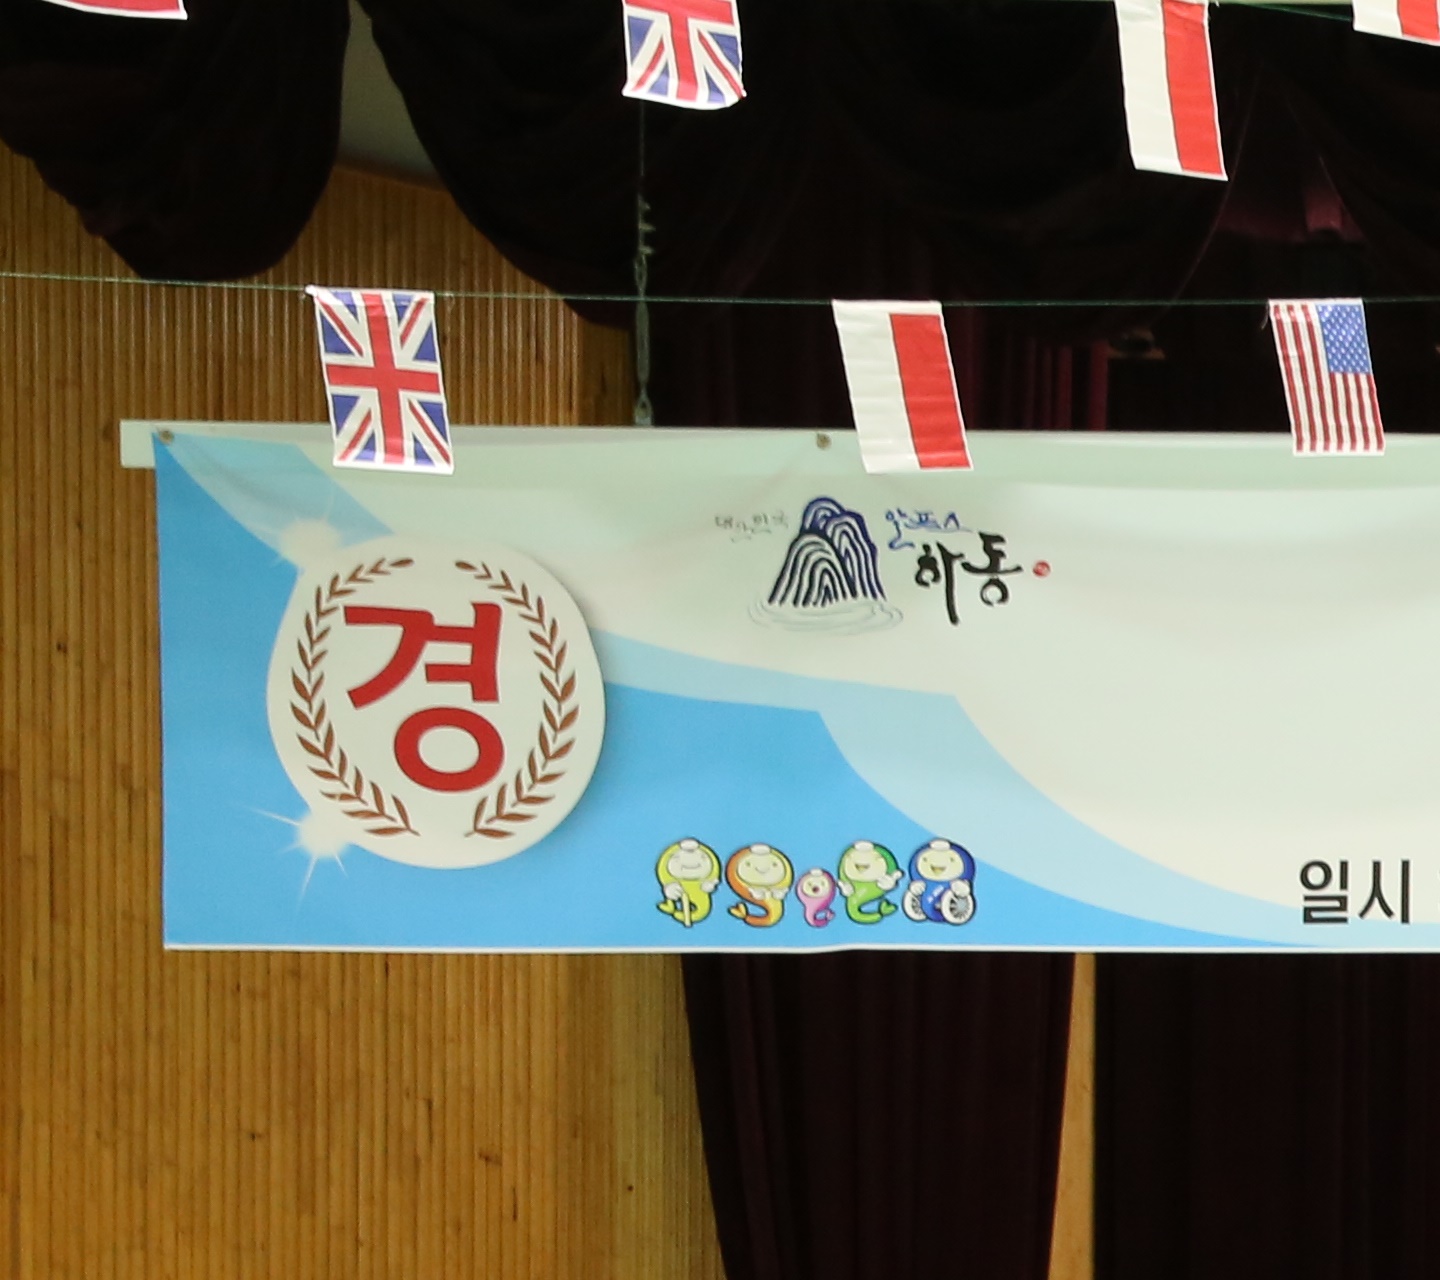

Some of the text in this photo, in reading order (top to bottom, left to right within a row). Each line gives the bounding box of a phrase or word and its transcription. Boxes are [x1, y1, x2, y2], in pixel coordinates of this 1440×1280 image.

[915, 532, 1024, 626] 하동
[342, 601, 506, 794] 경
[1300, 859, 1410, 925] 일시
